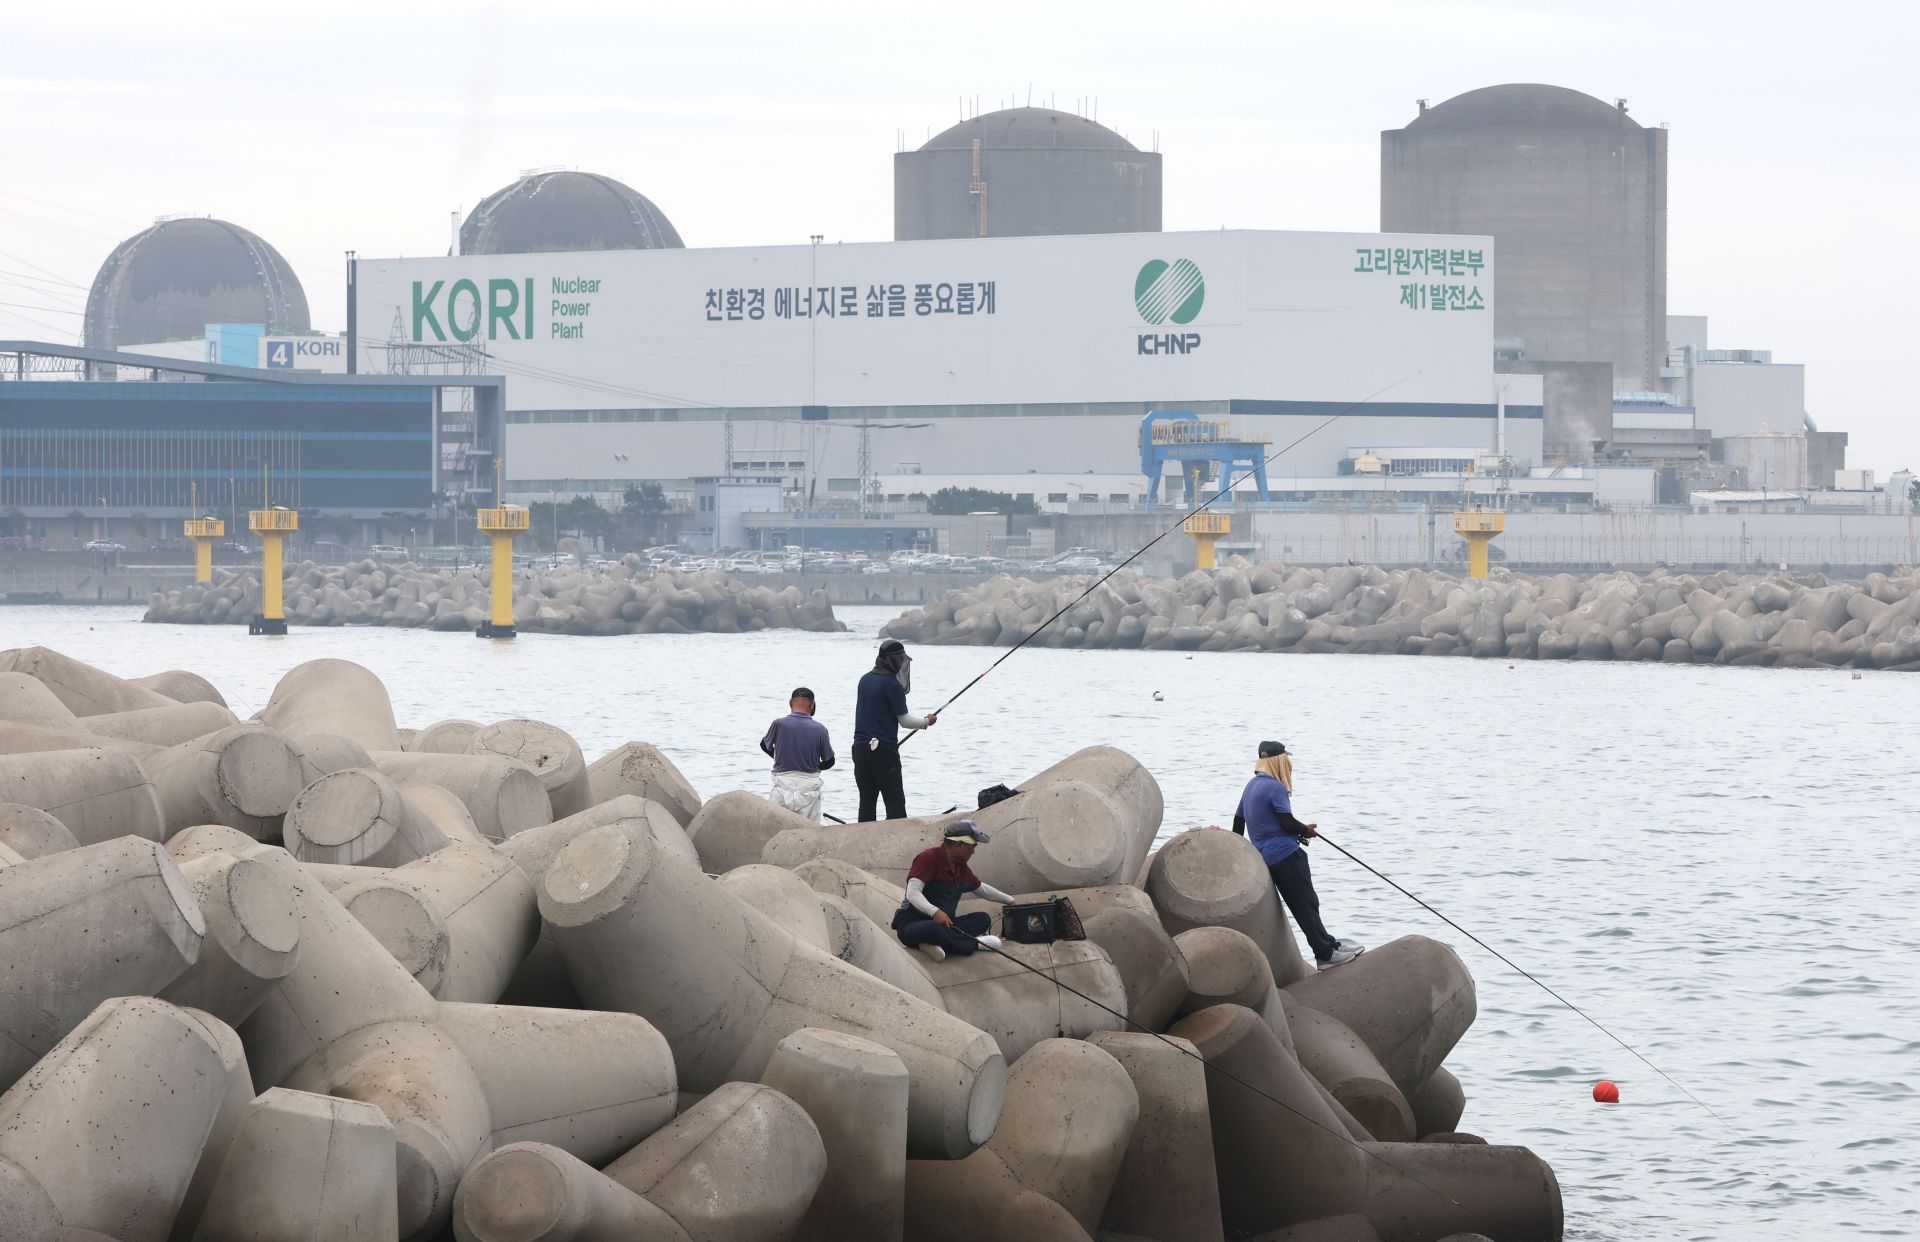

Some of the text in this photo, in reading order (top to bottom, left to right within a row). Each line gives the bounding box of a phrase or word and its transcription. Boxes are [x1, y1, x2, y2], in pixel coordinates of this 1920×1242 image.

[1354, 247, 1485, 277] 고리원자력본부
[552, 276, 601, 294] Nuclear
[412, 277, 534, 342] KORI
[551, 299, 590, 317] Power
[705, 280, 996, 322] 친환경 에너지로 삶을 풍요롭게
[551, 322, 584, 339] Plant
[271, 341, 340, 366] 4 KORI
[1137, 333, 1201, 355] KHNP
